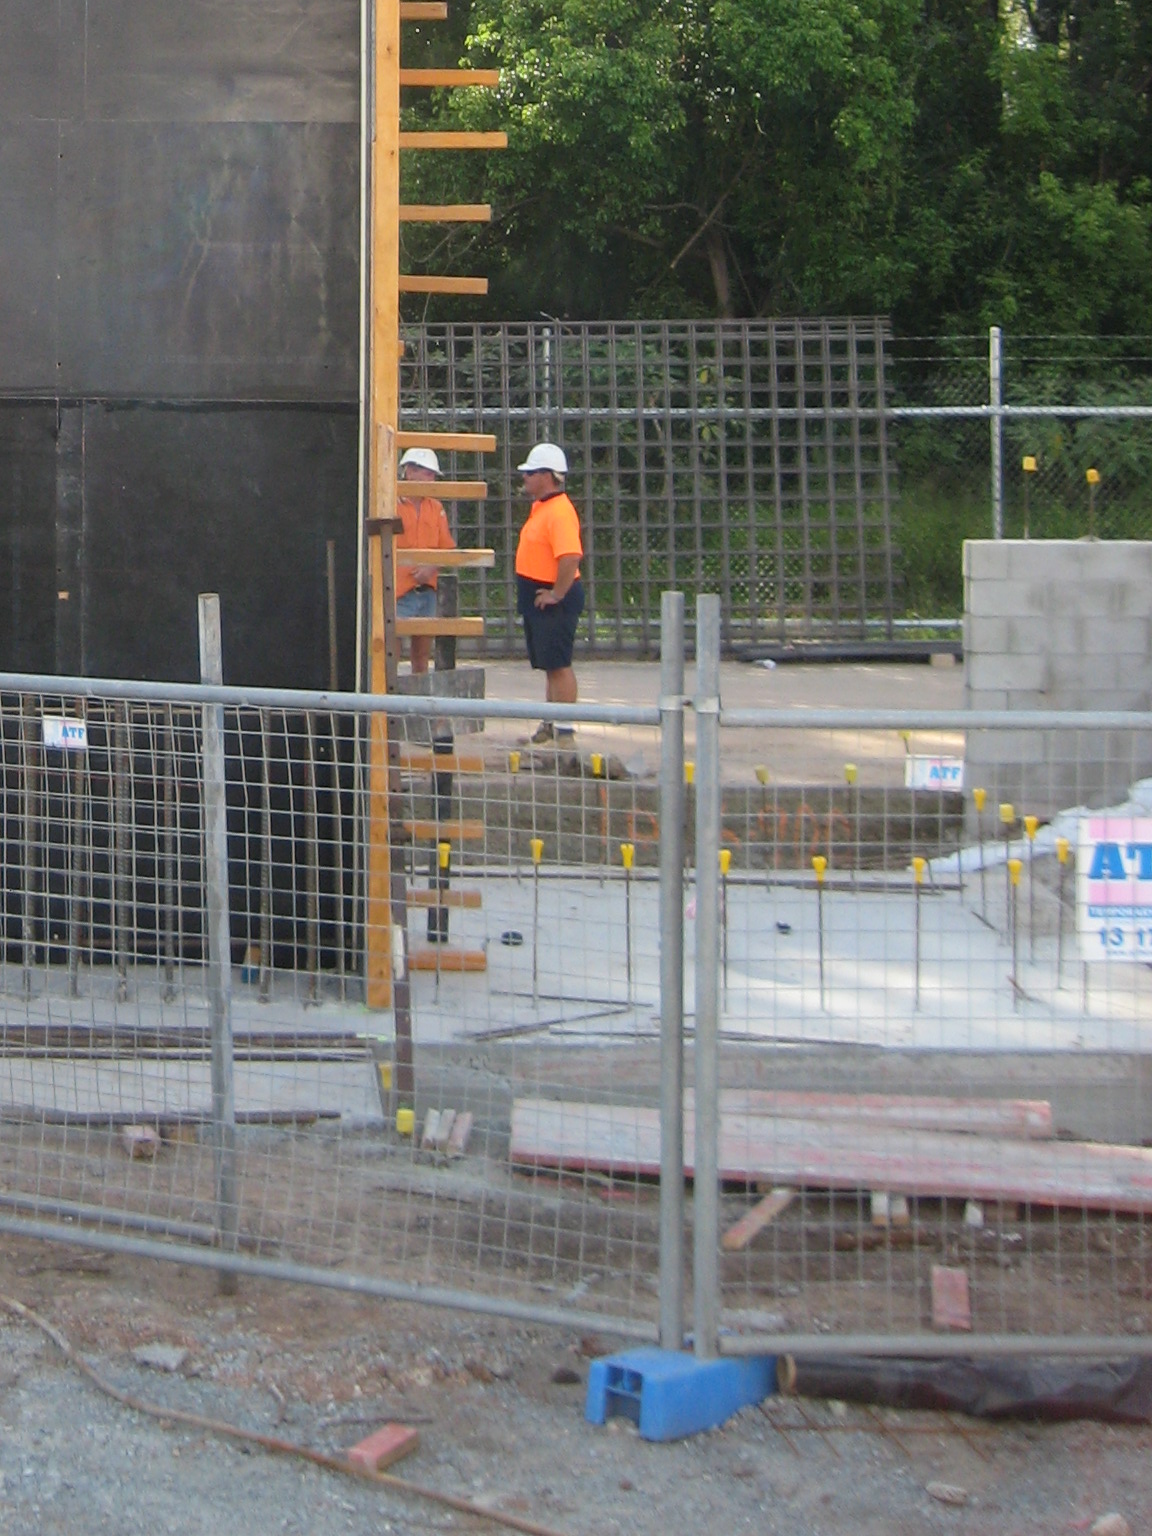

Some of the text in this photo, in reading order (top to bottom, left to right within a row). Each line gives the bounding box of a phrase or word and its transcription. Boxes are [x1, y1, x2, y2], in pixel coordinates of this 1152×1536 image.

[61, 725, 85, 739] ATF
[930, 766, 961, 780] ATF
[1100, 927, 1124, 946] 13
